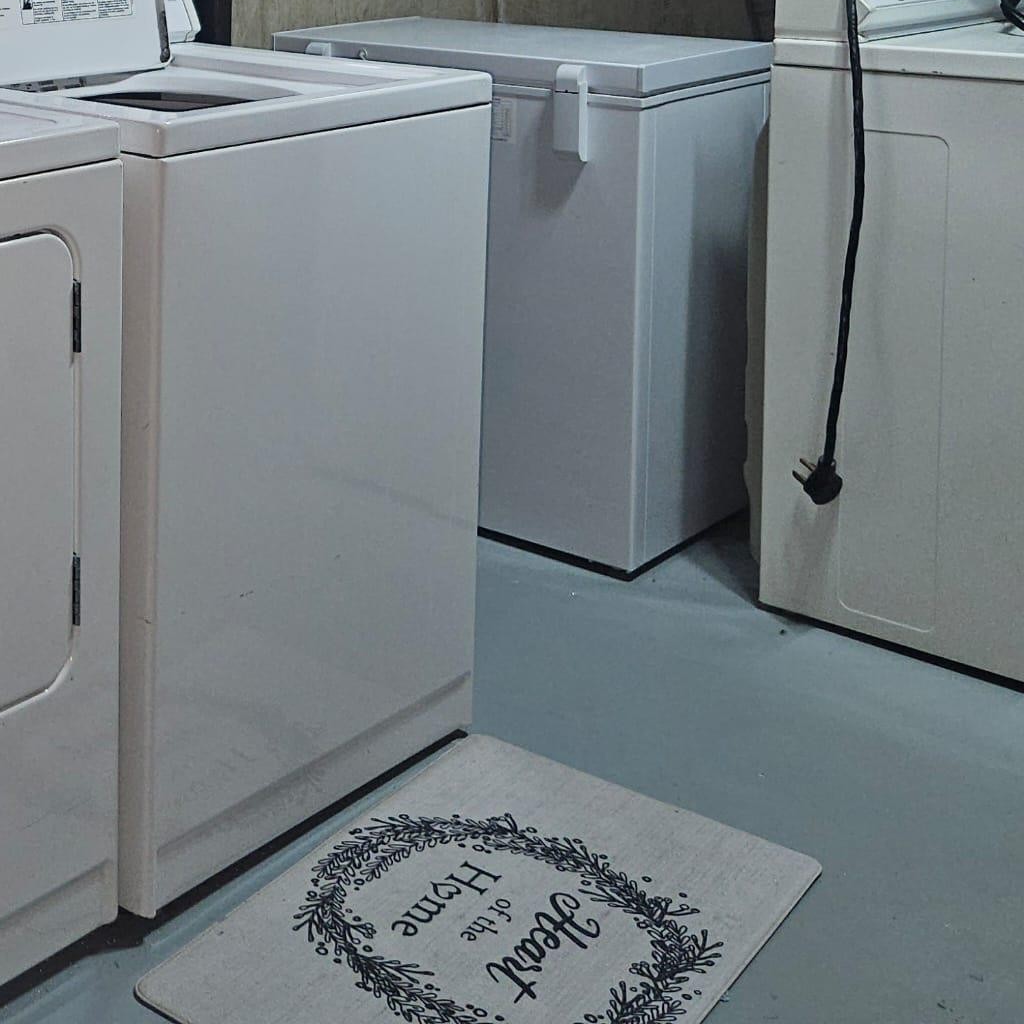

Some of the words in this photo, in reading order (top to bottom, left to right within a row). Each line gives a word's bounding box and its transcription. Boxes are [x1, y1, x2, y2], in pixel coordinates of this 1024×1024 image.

[391, 860, 503, 937] Home
[487, 898, 512, 923] of
[460, 916, 499, 942] the
[485, 892, 601, 1004] Heart
